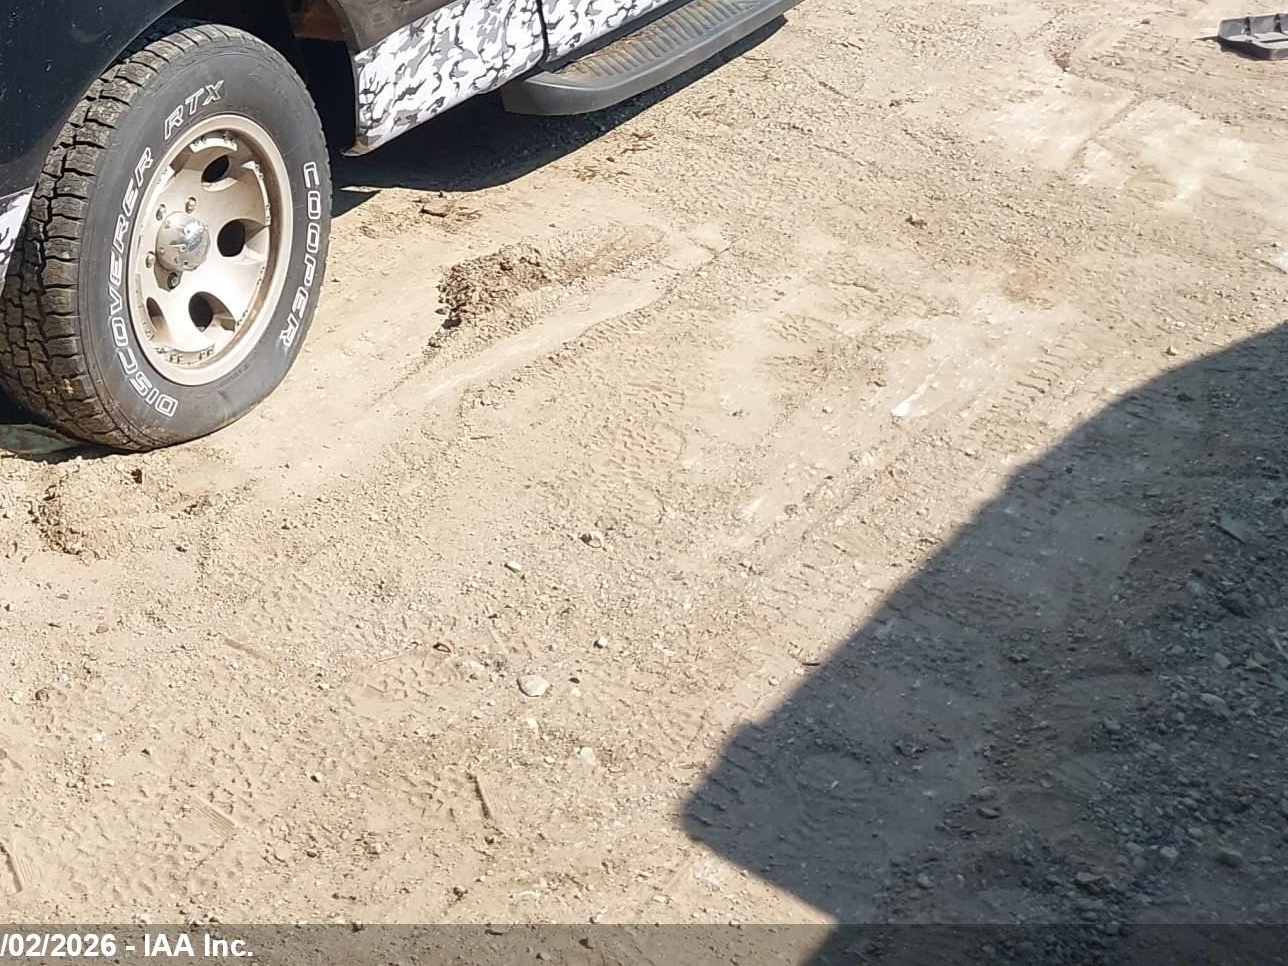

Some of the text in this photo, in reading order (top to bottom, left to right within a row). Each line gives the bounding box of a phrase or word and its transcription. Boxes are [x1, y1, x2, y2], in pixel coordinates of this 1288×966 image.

[106, 80, 224, 418] DISCOVERER RTX
[280, 161, 321, 349] COOPER
